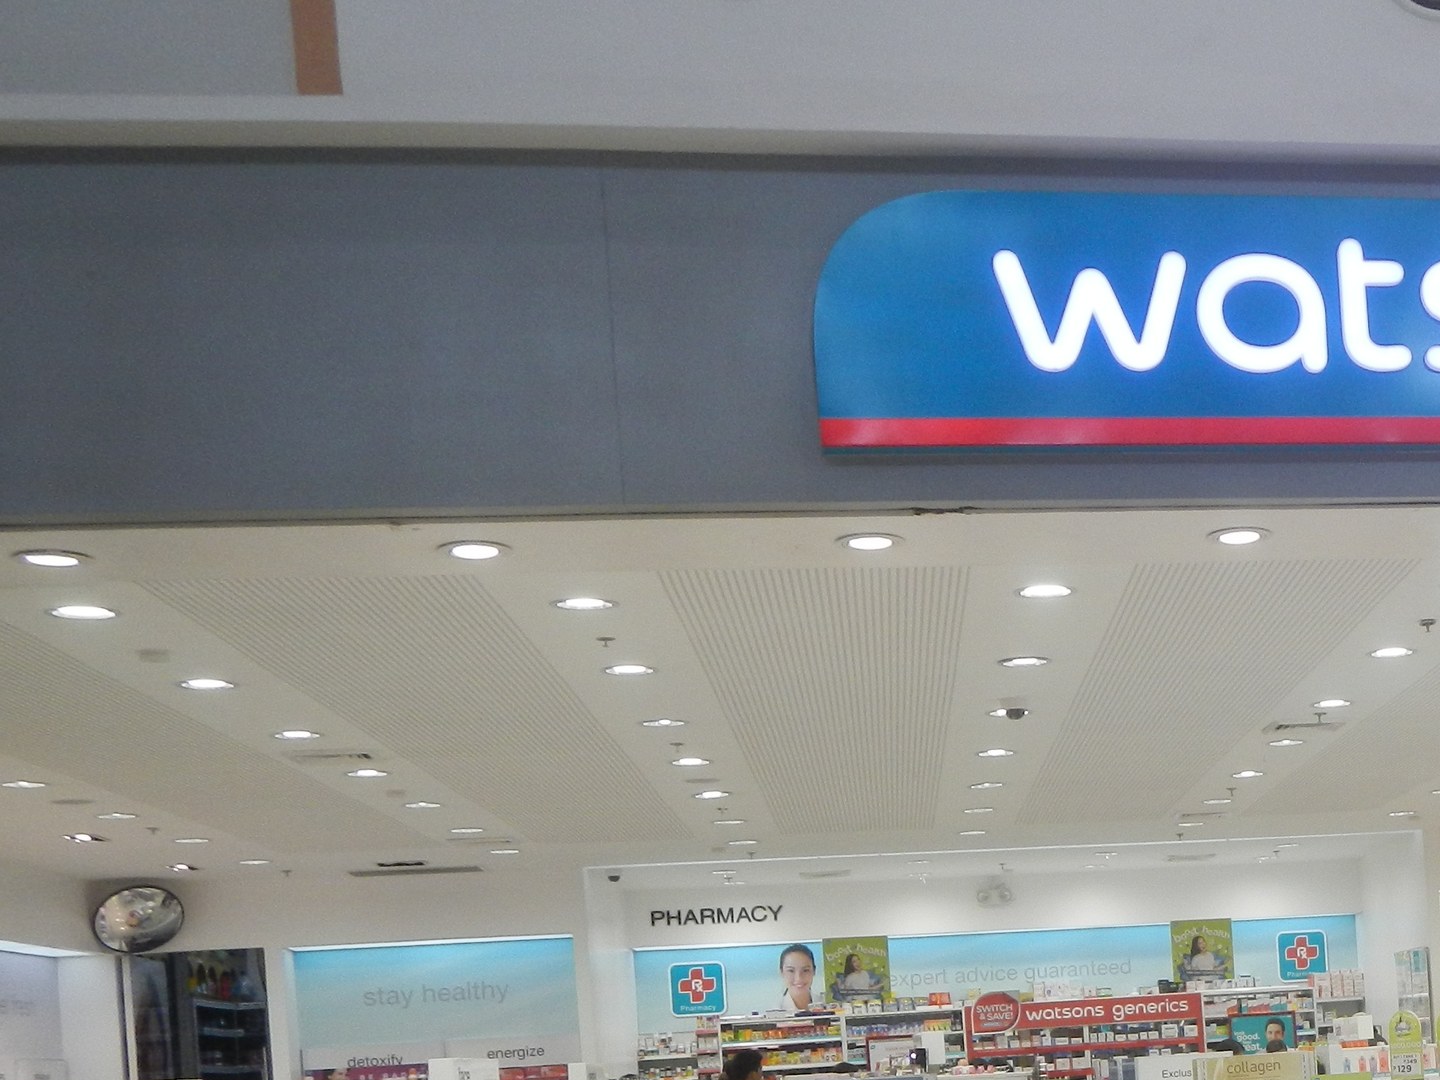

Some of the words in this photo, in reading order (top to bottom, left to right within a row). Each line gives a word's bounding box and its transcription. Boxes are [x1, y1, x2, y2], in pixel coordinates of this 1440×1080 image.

[650, 905, 783, 927] PHARMACY
[889, 968, 947, 988] expert
[955, 964, 1018, 984] advice
[1025, 959, 1132, 983] guaranteed
[363, 987, 413, 1009] stay
[422, 981, 509, 1003] healthy
[976, 1003, 1013, 1014] SWITCH
[1025, 1006, 1105, 1022] watsons
[1112, 999, 1189, 1021] generics
[347, 1053, 403, 1068] detoxify
[487, 1046, 545, 1060] energize
[1161, 1069, 1192, 1079] Exclus
[1226, 1060, 1281, 1076] collagen
